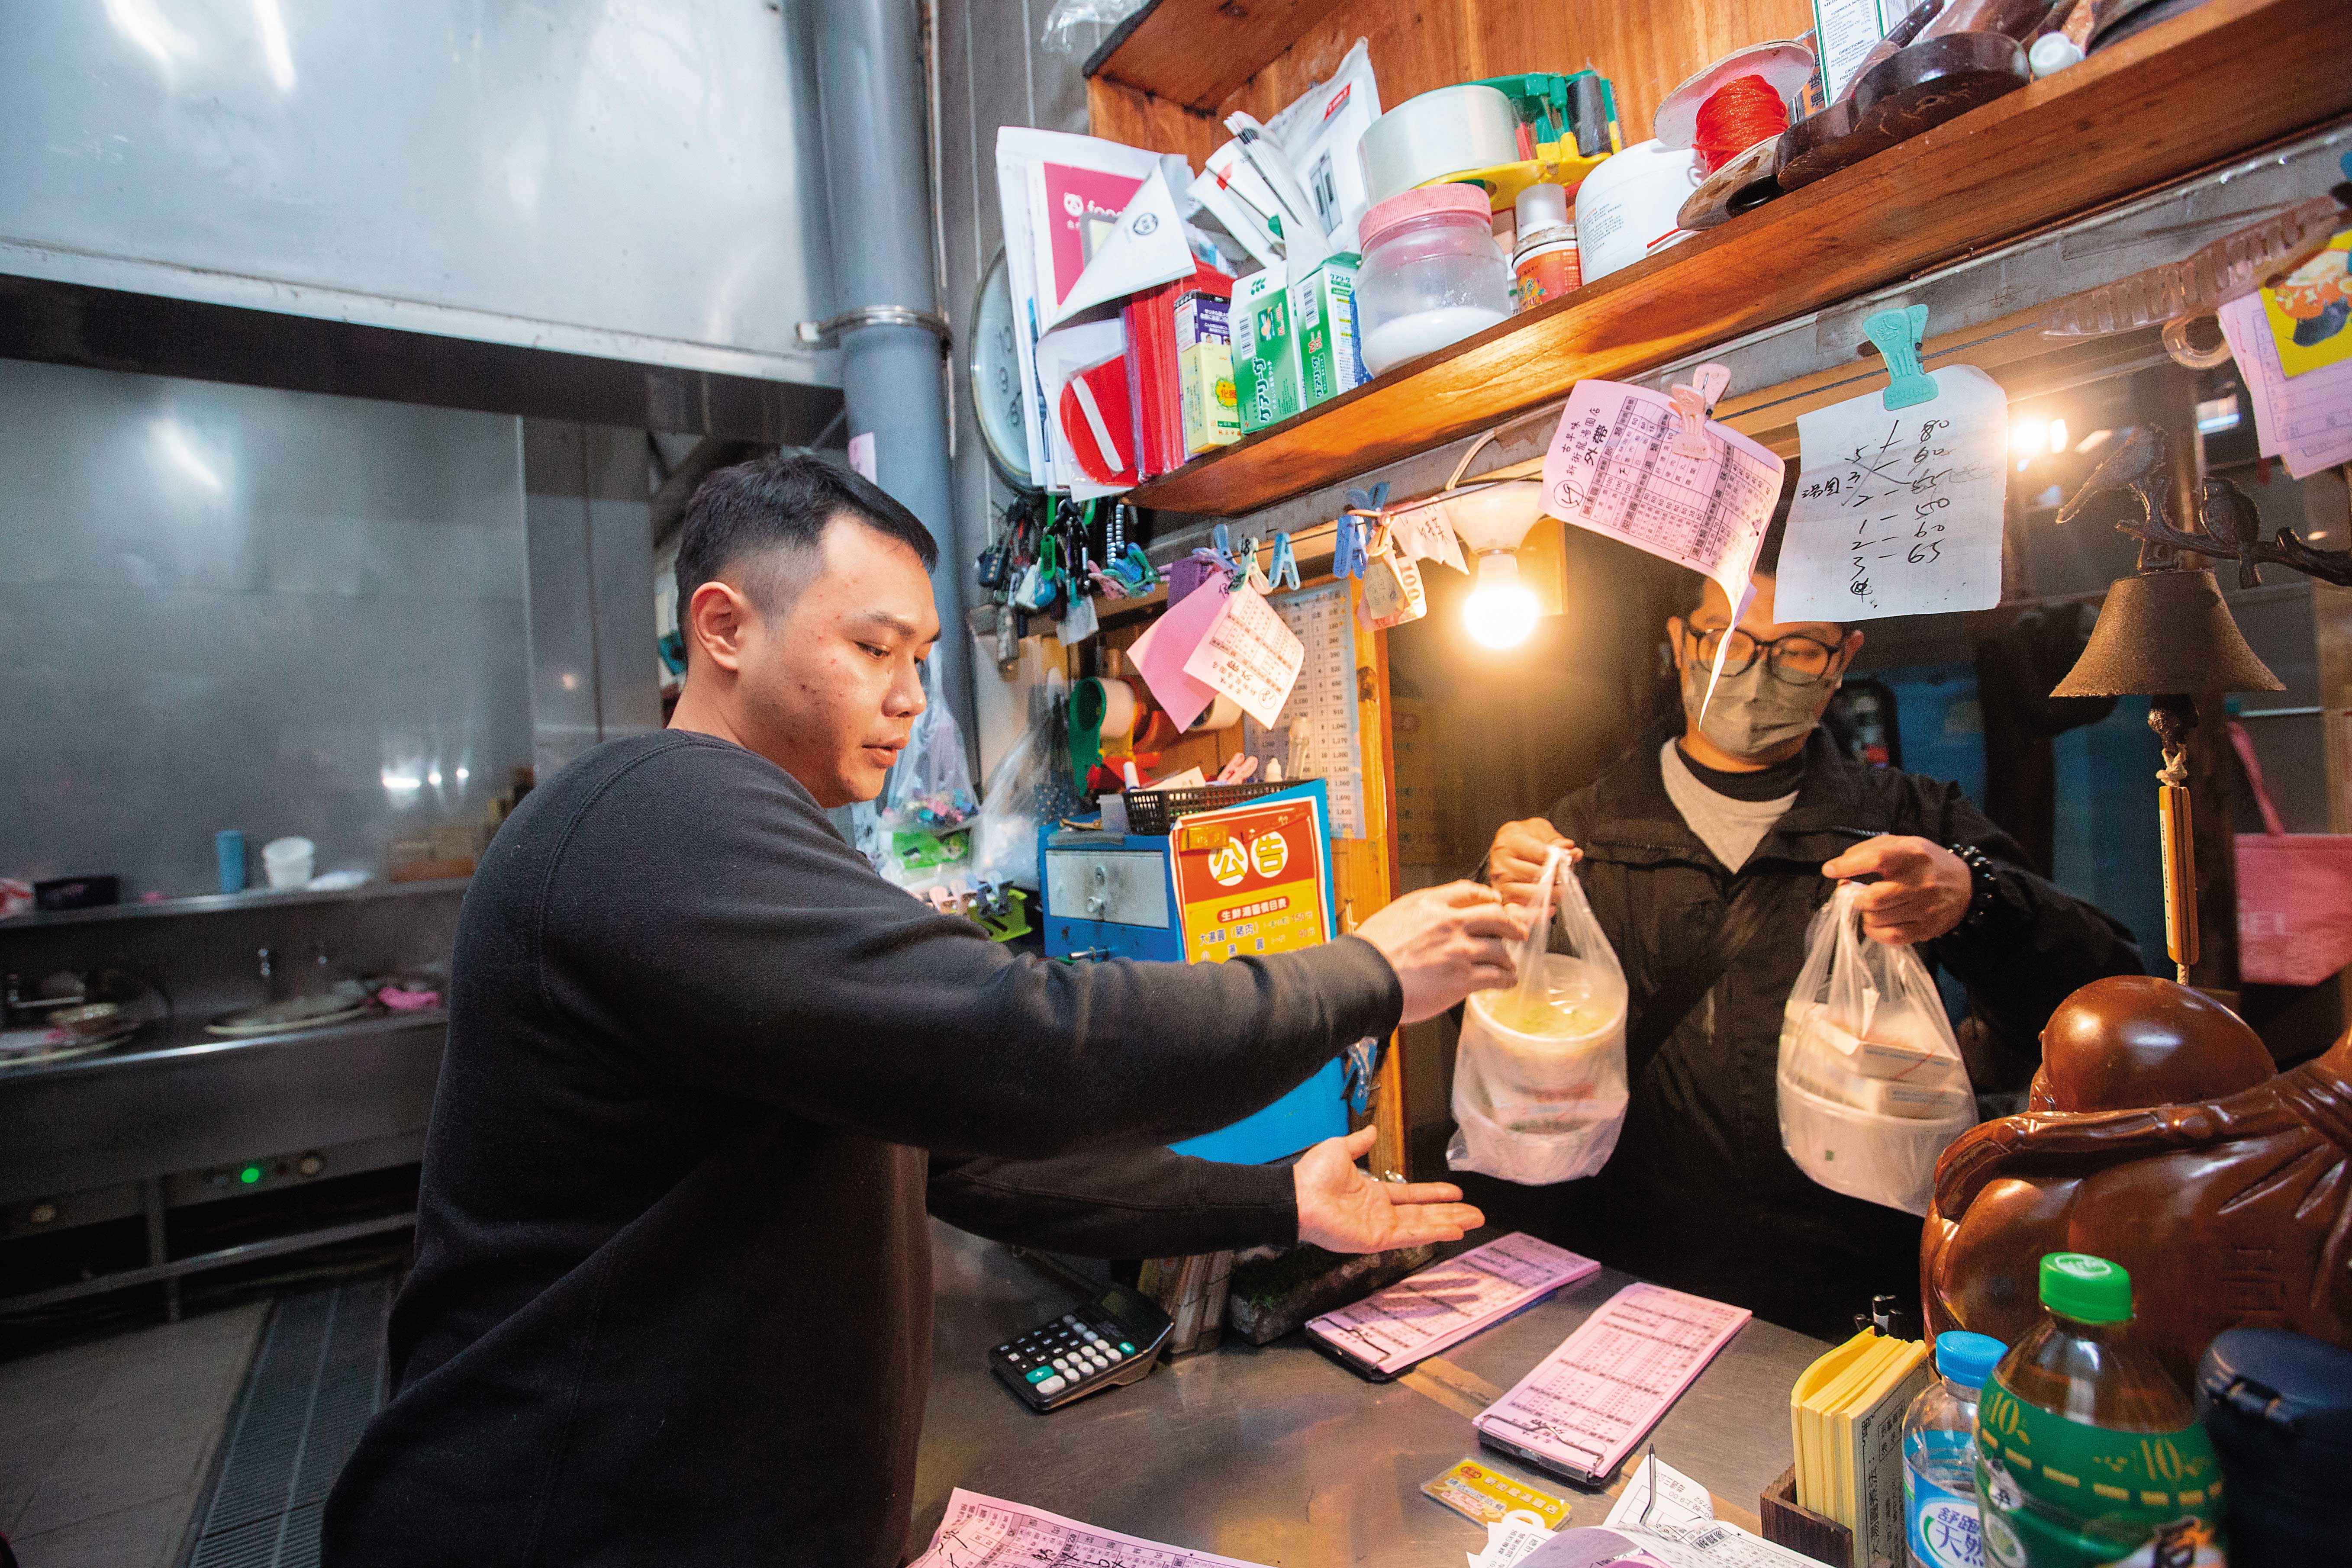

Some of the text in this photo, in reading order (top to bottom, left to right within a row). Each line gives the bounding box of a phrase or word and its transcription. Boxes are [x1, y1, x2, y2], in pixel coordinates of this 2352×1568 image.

[1830, 3, 1851, 16] FORMULA
[1851, 42, 1868, 52] affected
[1278, 326, 1285, 336] M
[1308, 341, 1316, 354] M
[1315, 336, 1322, 350] 50
[1312, 356, 1323, 398] ケアリーヴ
[1253, 357, 1272, 422] ケアリーヴ
[1560, 418, 1582, 454] 古早味
[1565, 405, 1600, 477] 新街龍湯圓店
[1583, 422, 1609, 466] 外帶
[1605, 417, 1639, 487] 100 60
[1643, 432, 1674, 500] 80 60
[1615, 479, 1623, 491] 100
[1624, 483, 1632, 495] 100
[1651, 495, 1657, 503] 80
[1658, 498, 1665, 506] 80
[1666, 501, 1672, 509] 80
[1673, 503, 1680, 512] 80
[1681, 506, 1688, 515] 80
[1689, 509, 1696, 518] 35
[1621, 500, 1638, 530] 甜湯圓
[1696, 512, 1703, 521] 80
[1914, 522, 1945, 538] 60
[1907, 538, 1946, 563] 65
[1212, 835, 1284, 882] 公告
[1199, 928, 1226, 946] 大湯圓
